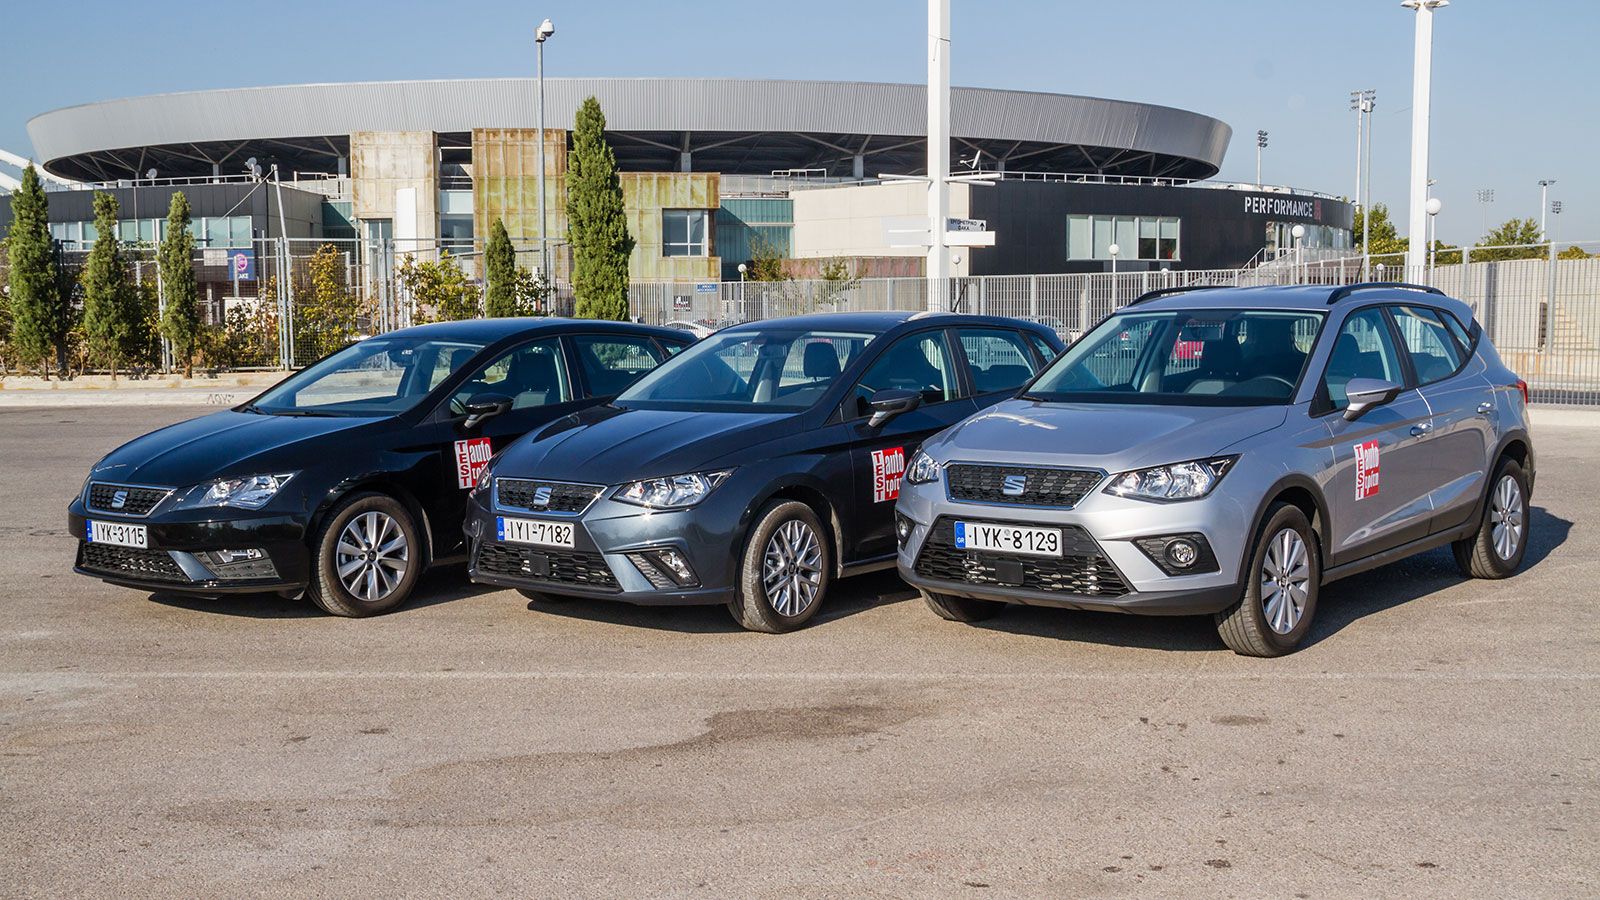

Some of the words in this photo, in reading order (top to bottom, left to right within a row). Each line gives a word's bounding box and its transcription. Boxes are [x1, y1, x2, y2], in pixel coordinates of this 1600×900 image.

[1244, 196, 1313, 217] PERFORMANCE
[457, 441, 470, 487] TEST
[469, 440, 492, 463] auto
[885, 449, 904, 475] auto
[873, 452, 884, 501] TEST
[1354, 445, 1364, 498] TEST
